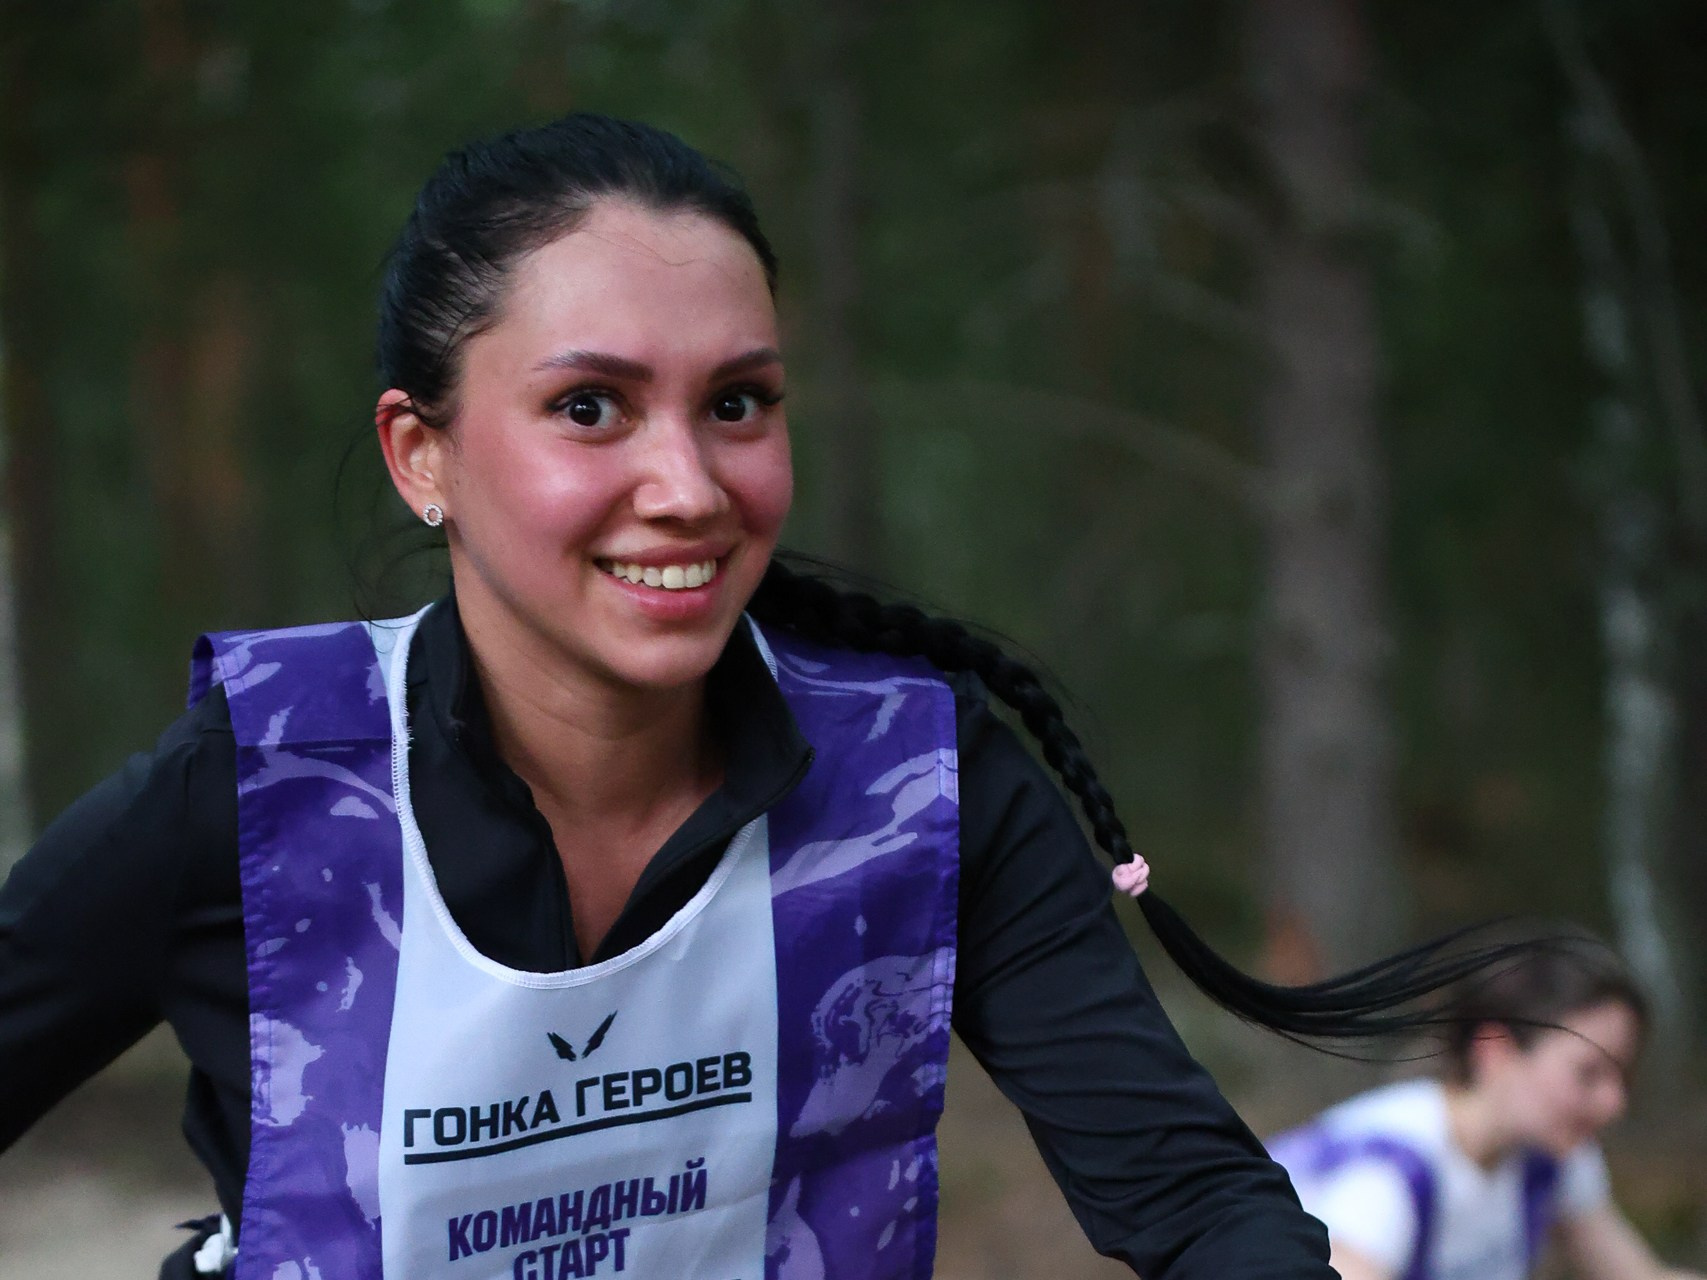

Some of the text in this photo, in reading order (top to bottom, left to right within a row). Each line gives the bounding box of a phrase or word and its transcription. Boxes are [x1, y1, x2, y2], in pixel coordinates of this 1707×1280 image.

[403, 1050, 752, 1147] ГОНКА ГЕРОЕВ
[448, 1157, 708, 1262] КОМАНДНЫЙ
